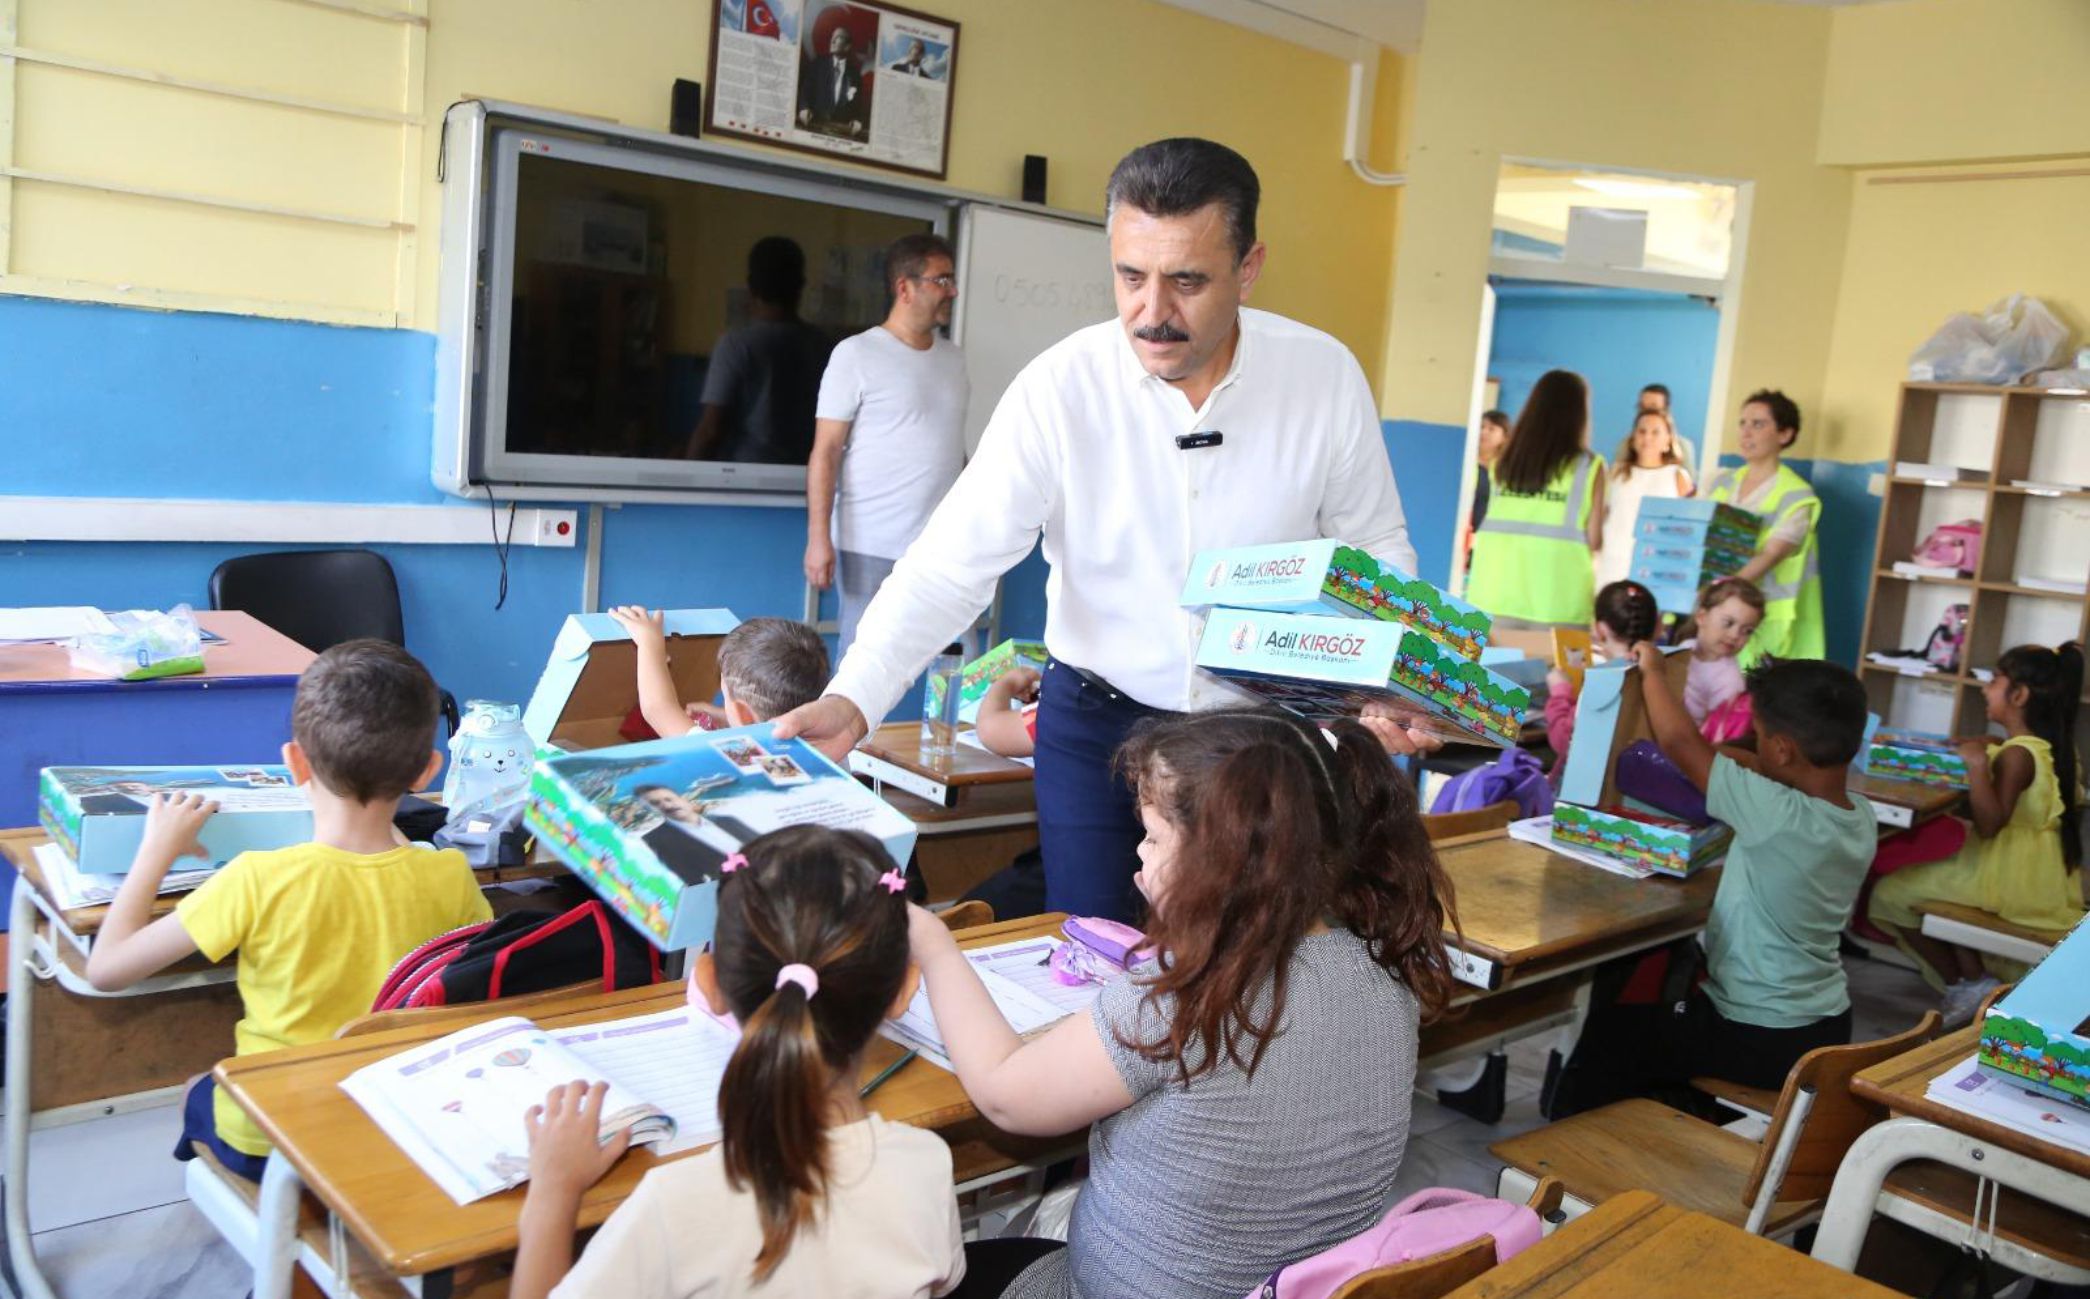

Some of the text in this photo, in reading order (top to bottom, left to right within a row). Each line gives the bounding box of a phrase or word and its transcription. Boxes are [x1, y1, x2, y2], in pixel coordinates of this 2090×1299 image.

[1232, 554, 1307, 580] Adil KIRGÖZ
[1264, 630, 1366, 656] Adil KIRGÖZ
